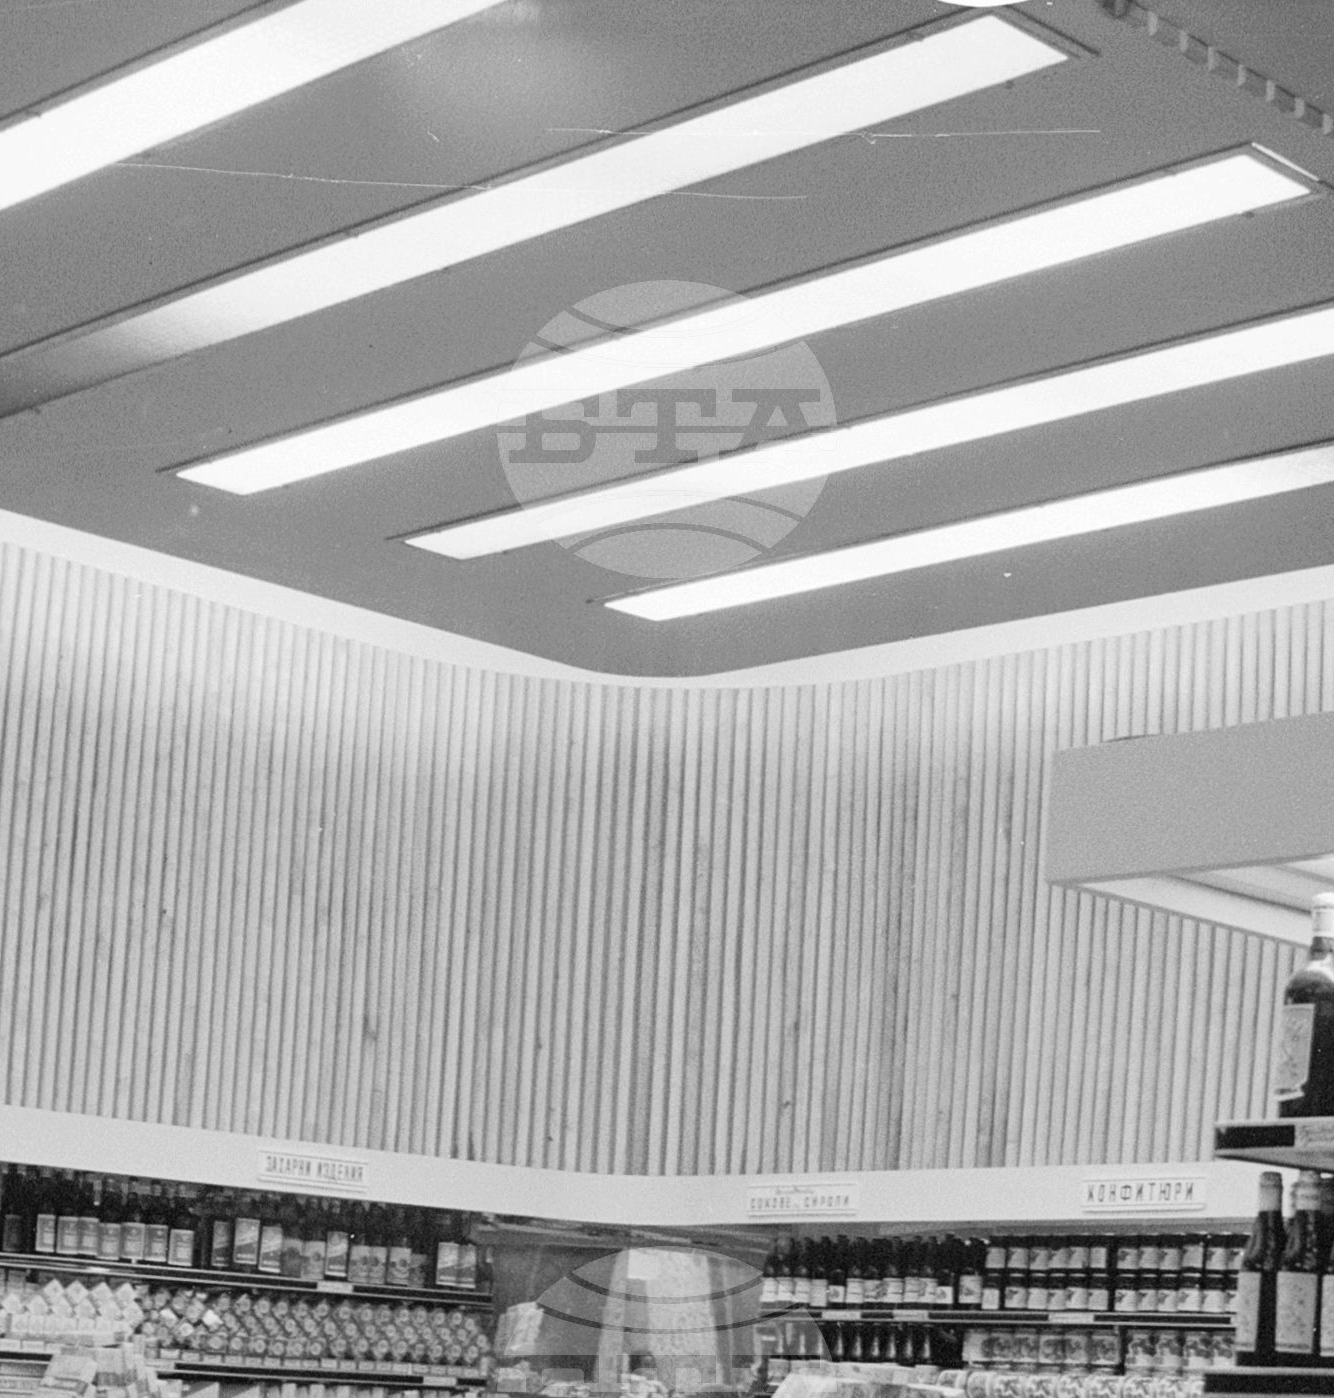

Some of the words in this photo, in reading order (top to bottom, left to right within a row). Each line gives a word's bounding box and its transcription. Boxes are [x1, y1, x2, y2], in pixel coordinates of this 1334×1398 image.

[266, 1155, 311, 1176] ЗАХАРНИ
[317, 1161, 363, 1182] ИЗДЕЛИЯ
[1086, 1182, 1194, 1203] КОНФИТЮРИ
